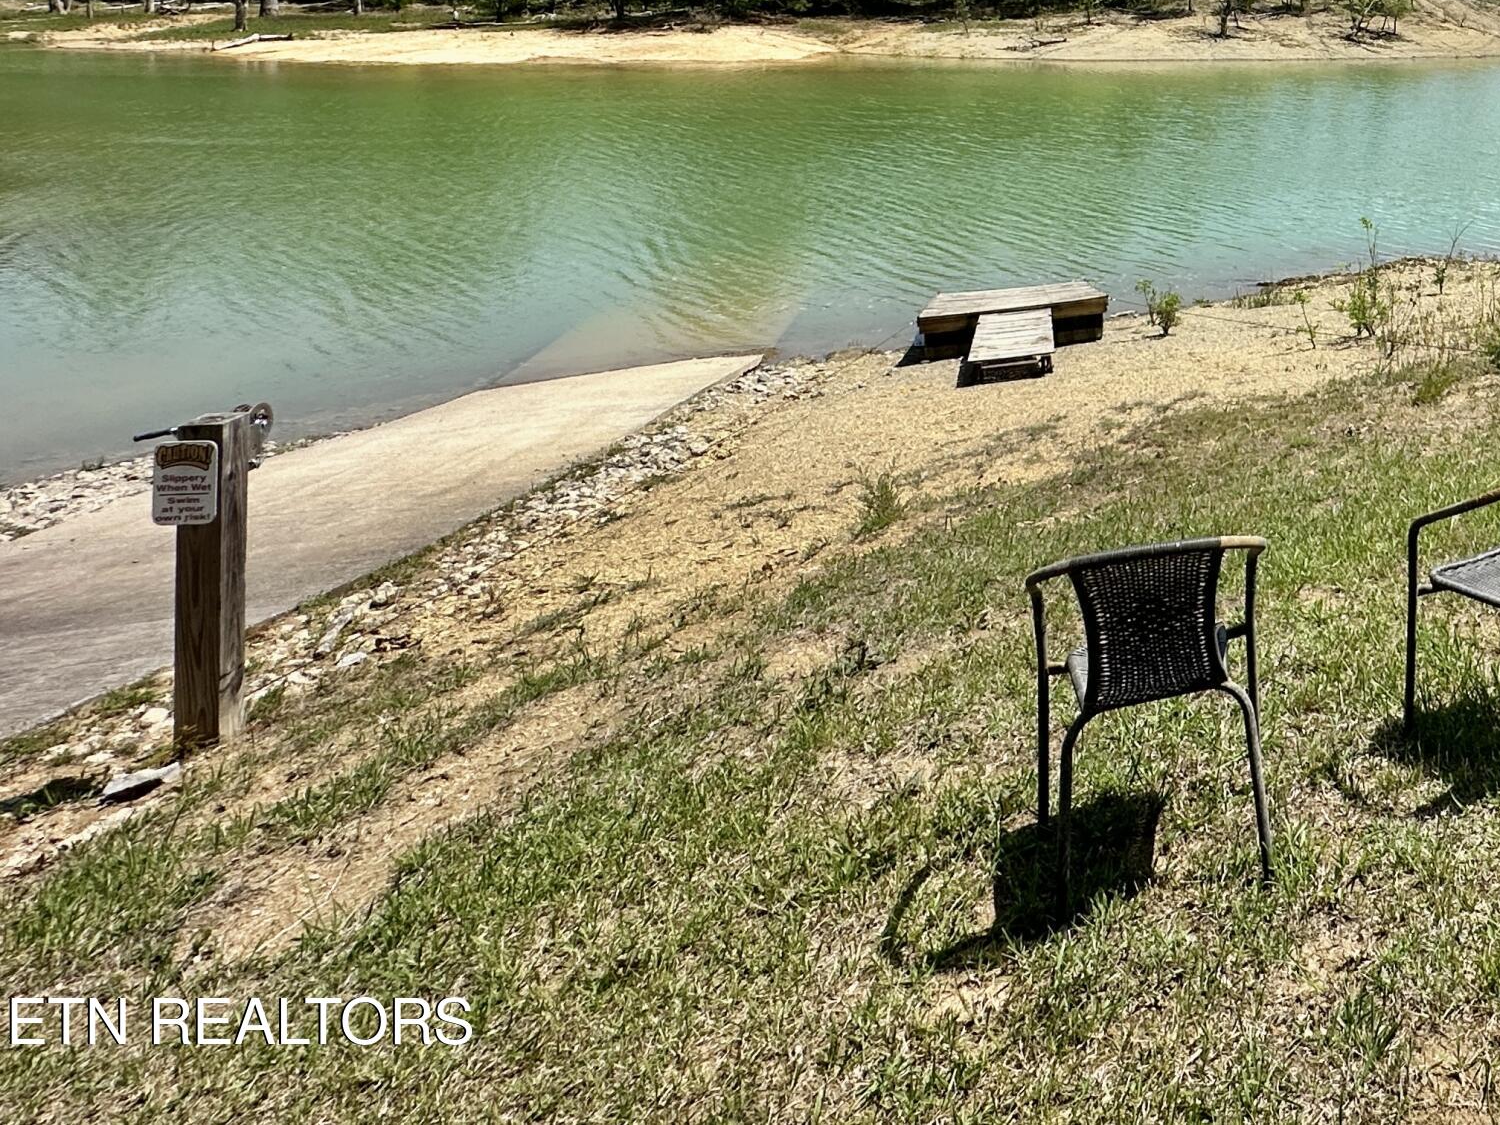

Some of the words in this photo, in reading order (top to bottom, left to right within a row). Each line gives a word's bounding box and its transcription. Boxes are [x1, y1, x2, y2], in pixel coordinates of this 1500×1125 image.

[157, 444, 213, 465] CAUTION!
[162, 475, 206, 484] Slippery
[157, 484, 187, 492] When
[192, 484, 211, 492] Wet
[178, 506, 204, 514] your
[184, 513, 210, 522] risk!
